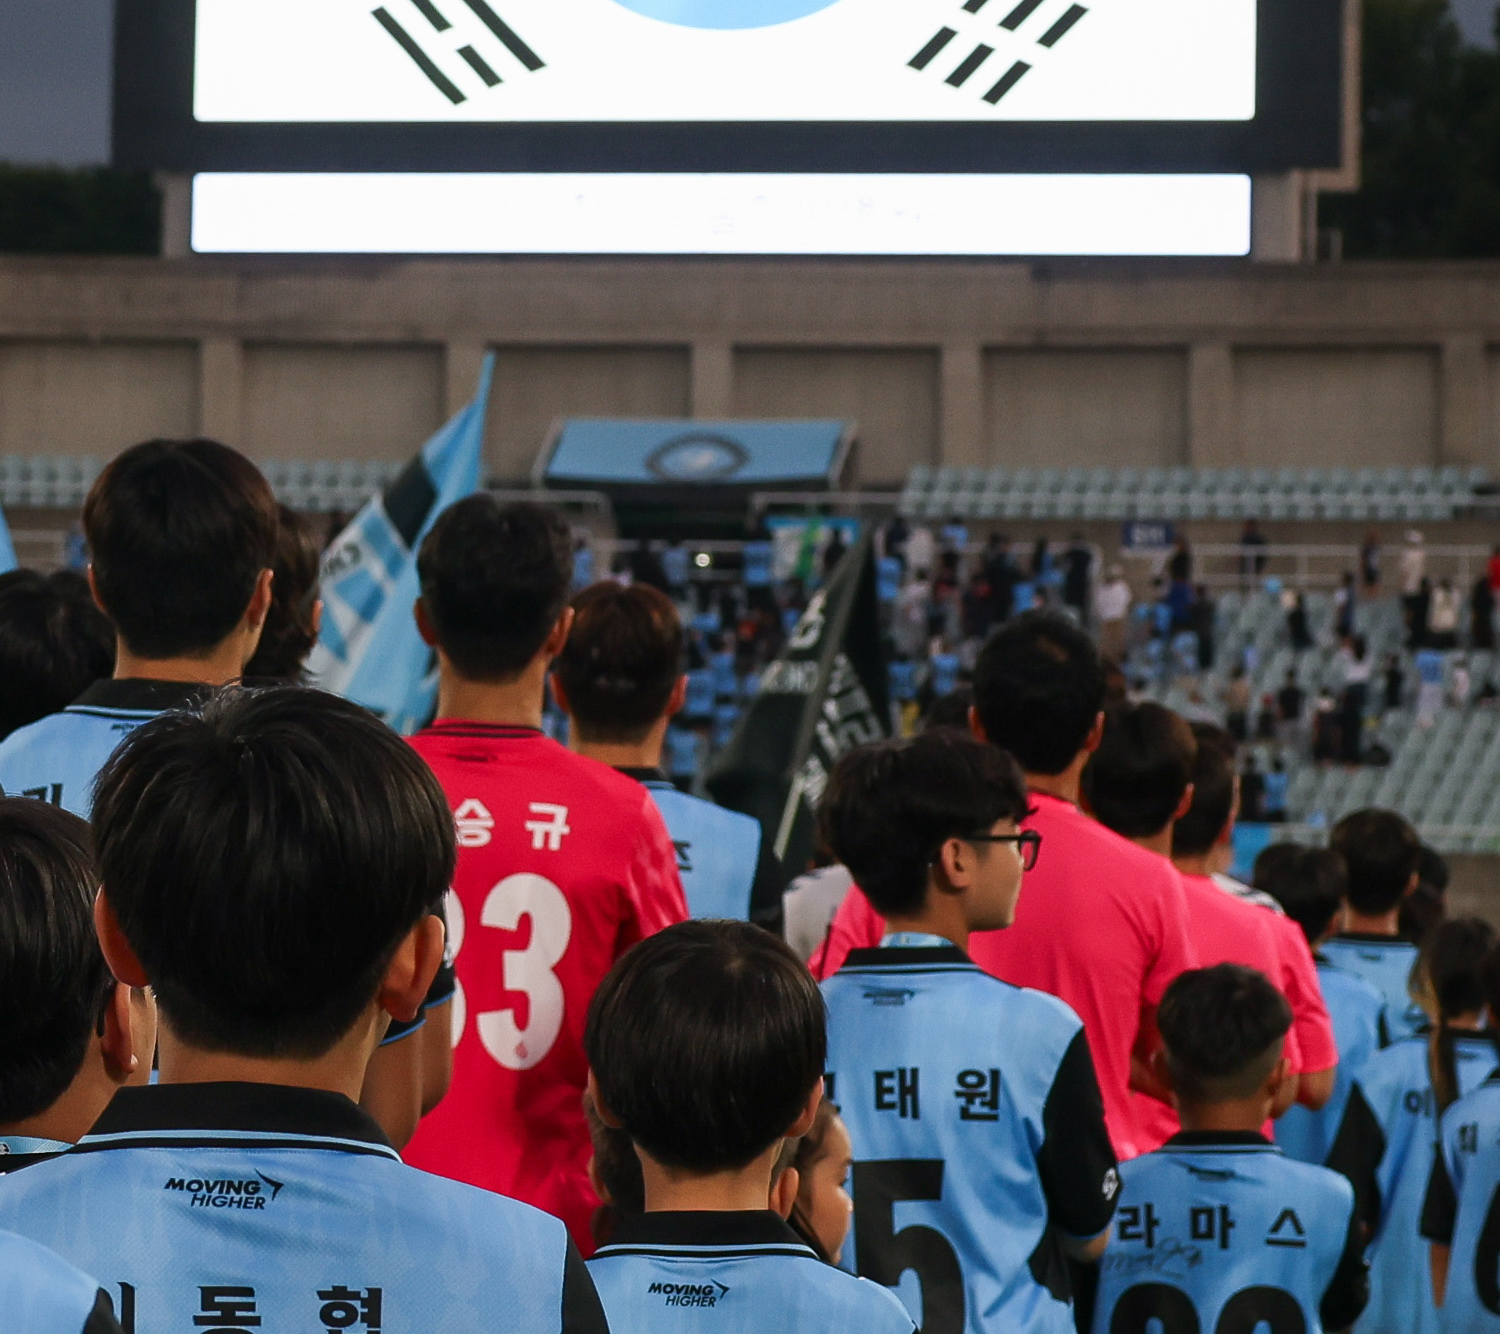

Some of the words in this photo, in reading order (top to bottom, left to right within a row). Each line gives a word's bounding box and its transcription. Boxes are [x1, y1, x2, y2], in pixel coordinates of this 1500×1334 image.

[822, 1067, 1001, 1122] 태원
[163, 1177, 261, 1195] MOVING
[190, 1192, 267, 1210] HIGHER
[1117, 1202, 1308, 1251] 라마스
[647, 1282, 714, 1297] MOVING
[665, 1295, 717, 1308] HIGHER
